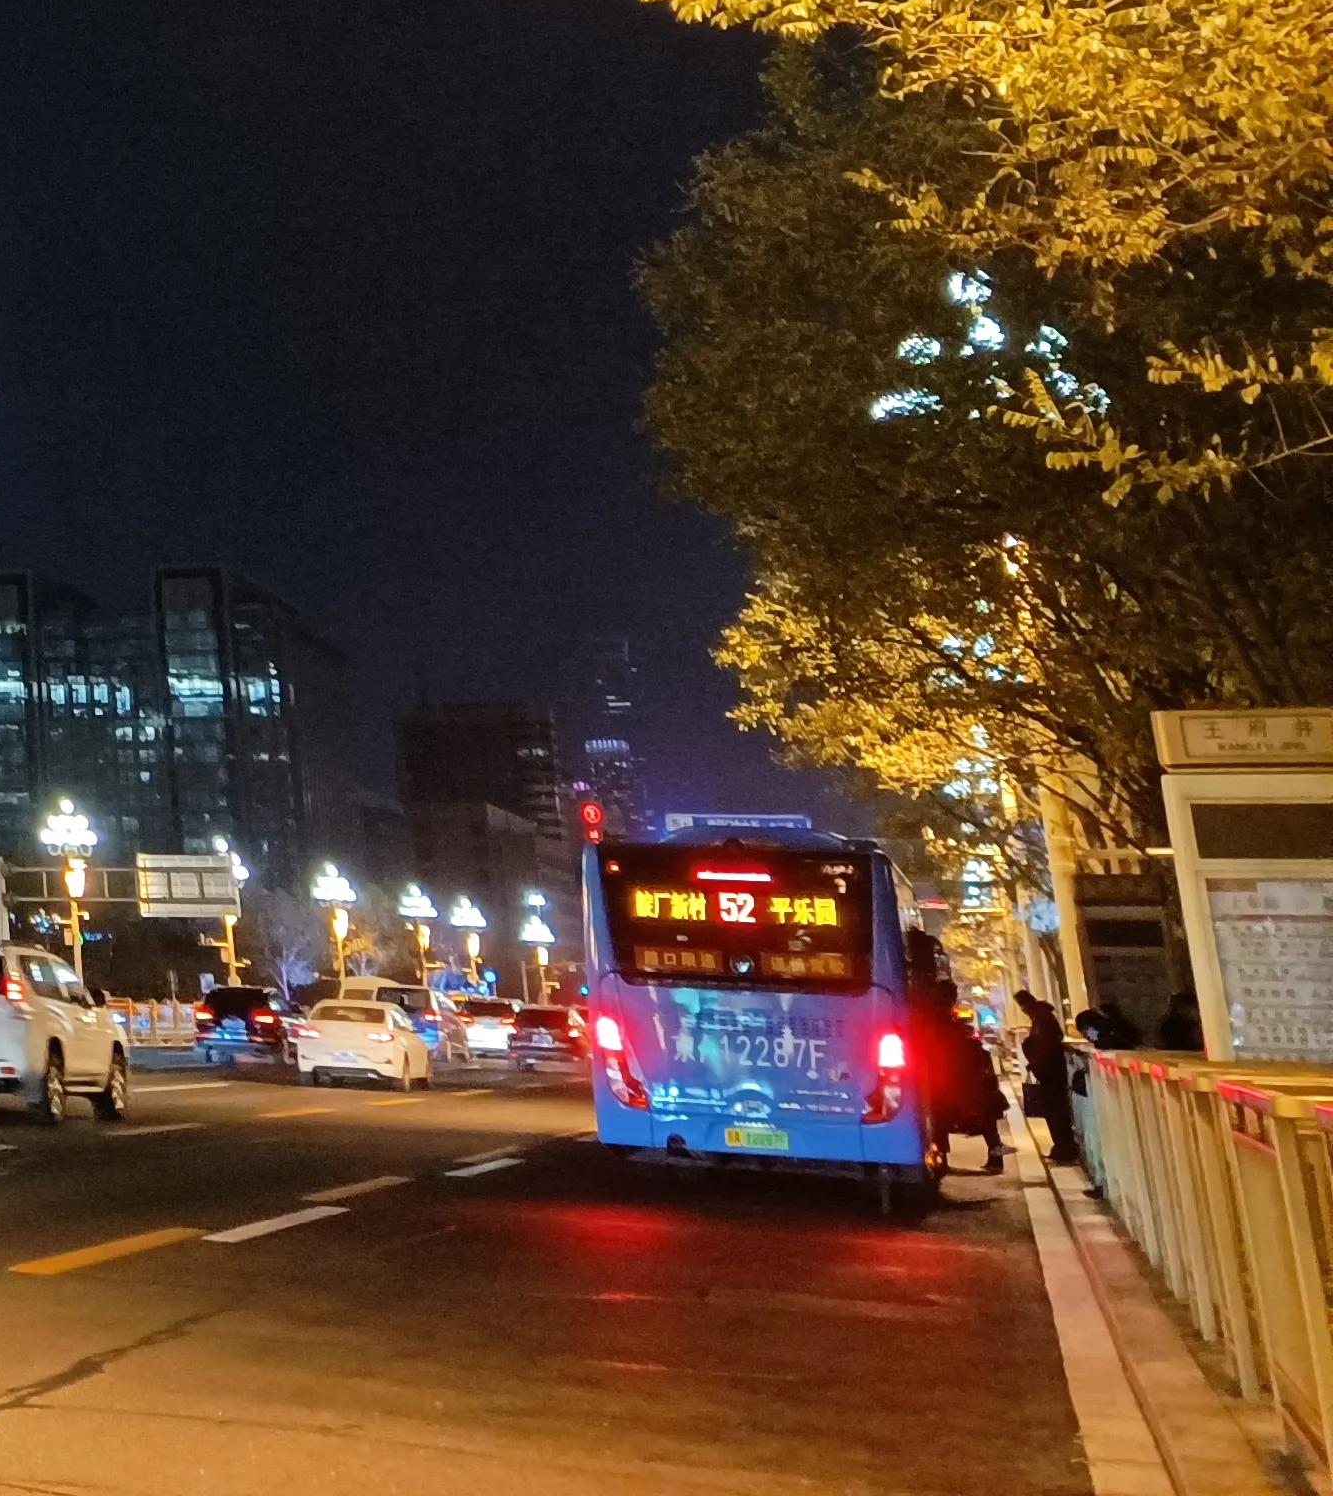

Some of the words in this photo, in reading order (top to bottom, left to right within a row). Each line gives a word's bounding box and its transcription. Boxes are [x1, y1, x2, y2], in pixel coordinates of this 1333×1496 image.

[719, 892, 756, 923] 52
[770, 897, 837, 925] 平乐园
